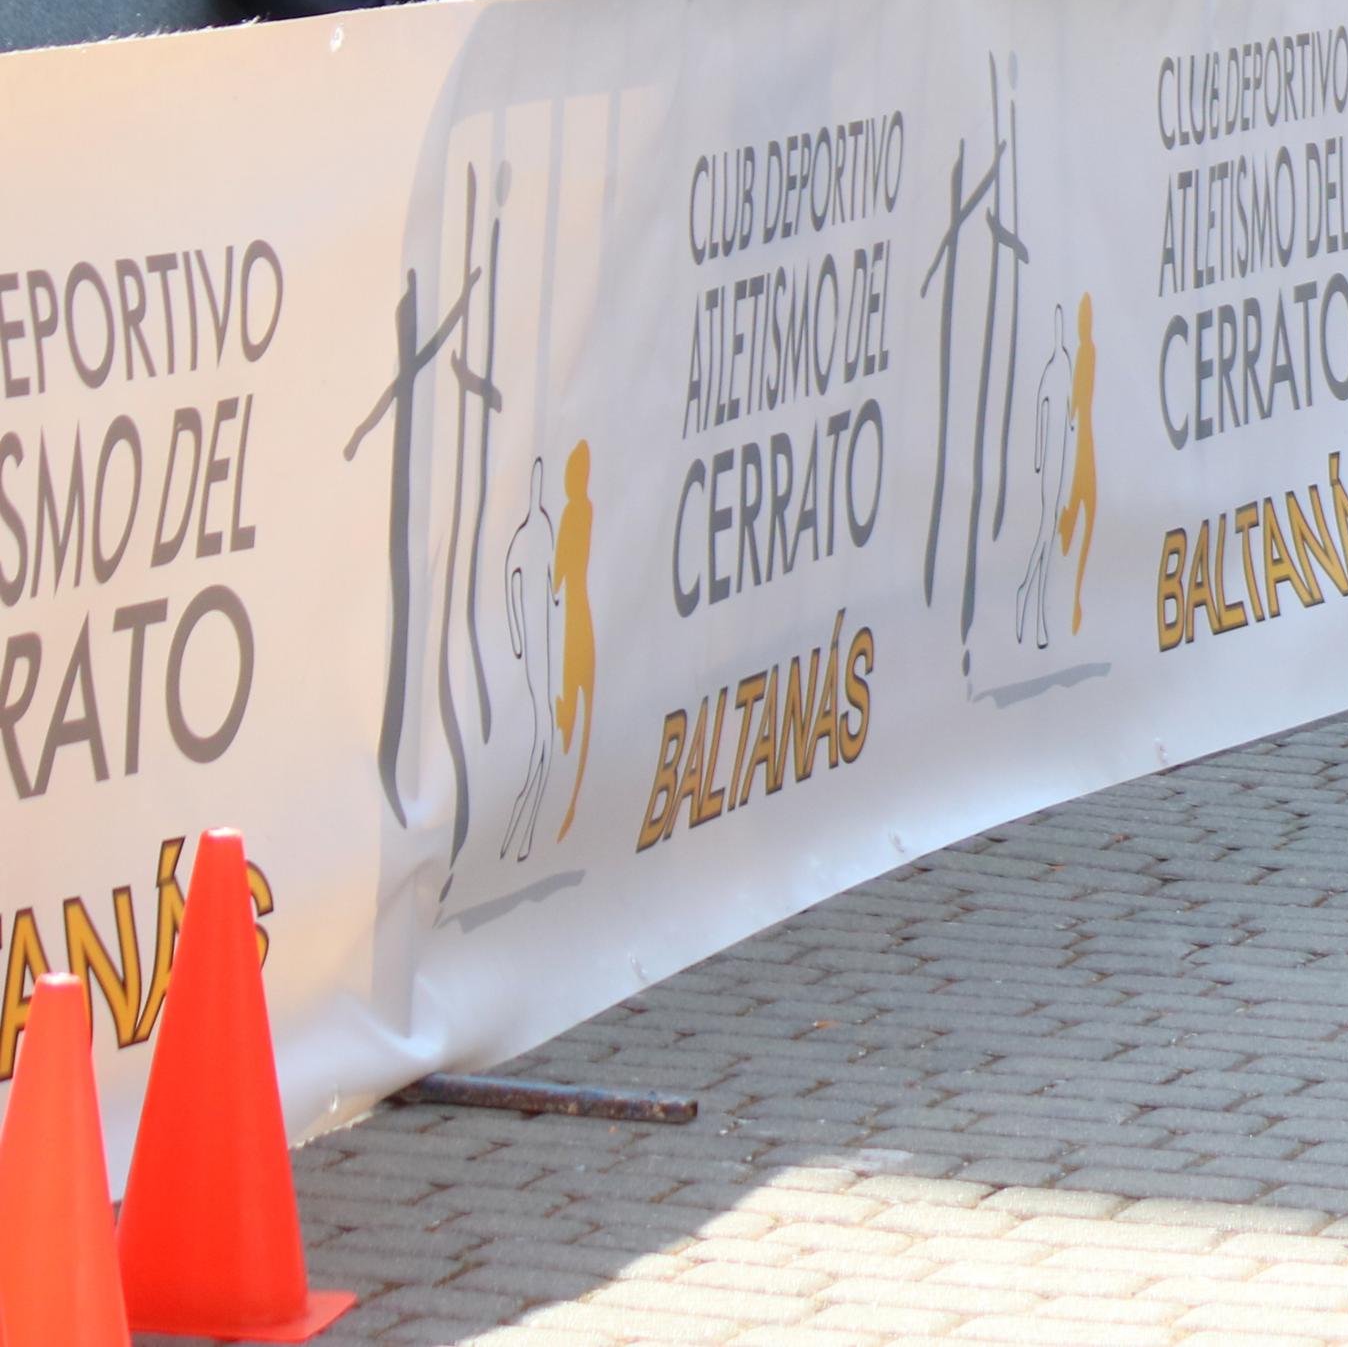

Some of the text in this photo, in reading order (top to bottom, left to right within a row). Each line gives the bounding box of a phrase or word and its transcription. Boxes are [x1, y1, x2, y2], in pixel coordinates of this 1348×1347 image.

[689, 110, 903, 266] CLUB DEPORTIVO
[1158, 52, 1219, 150] CLUB
[1158, 146, 1296, 298] ATLETISMO
[683, 240, 891, 440] ATLETISMO DEL
[150, 393, 257, 569] DEL
[673, 398, 883, 618] CERRATO
[636, 607, 874, 854] BALTANÁS
